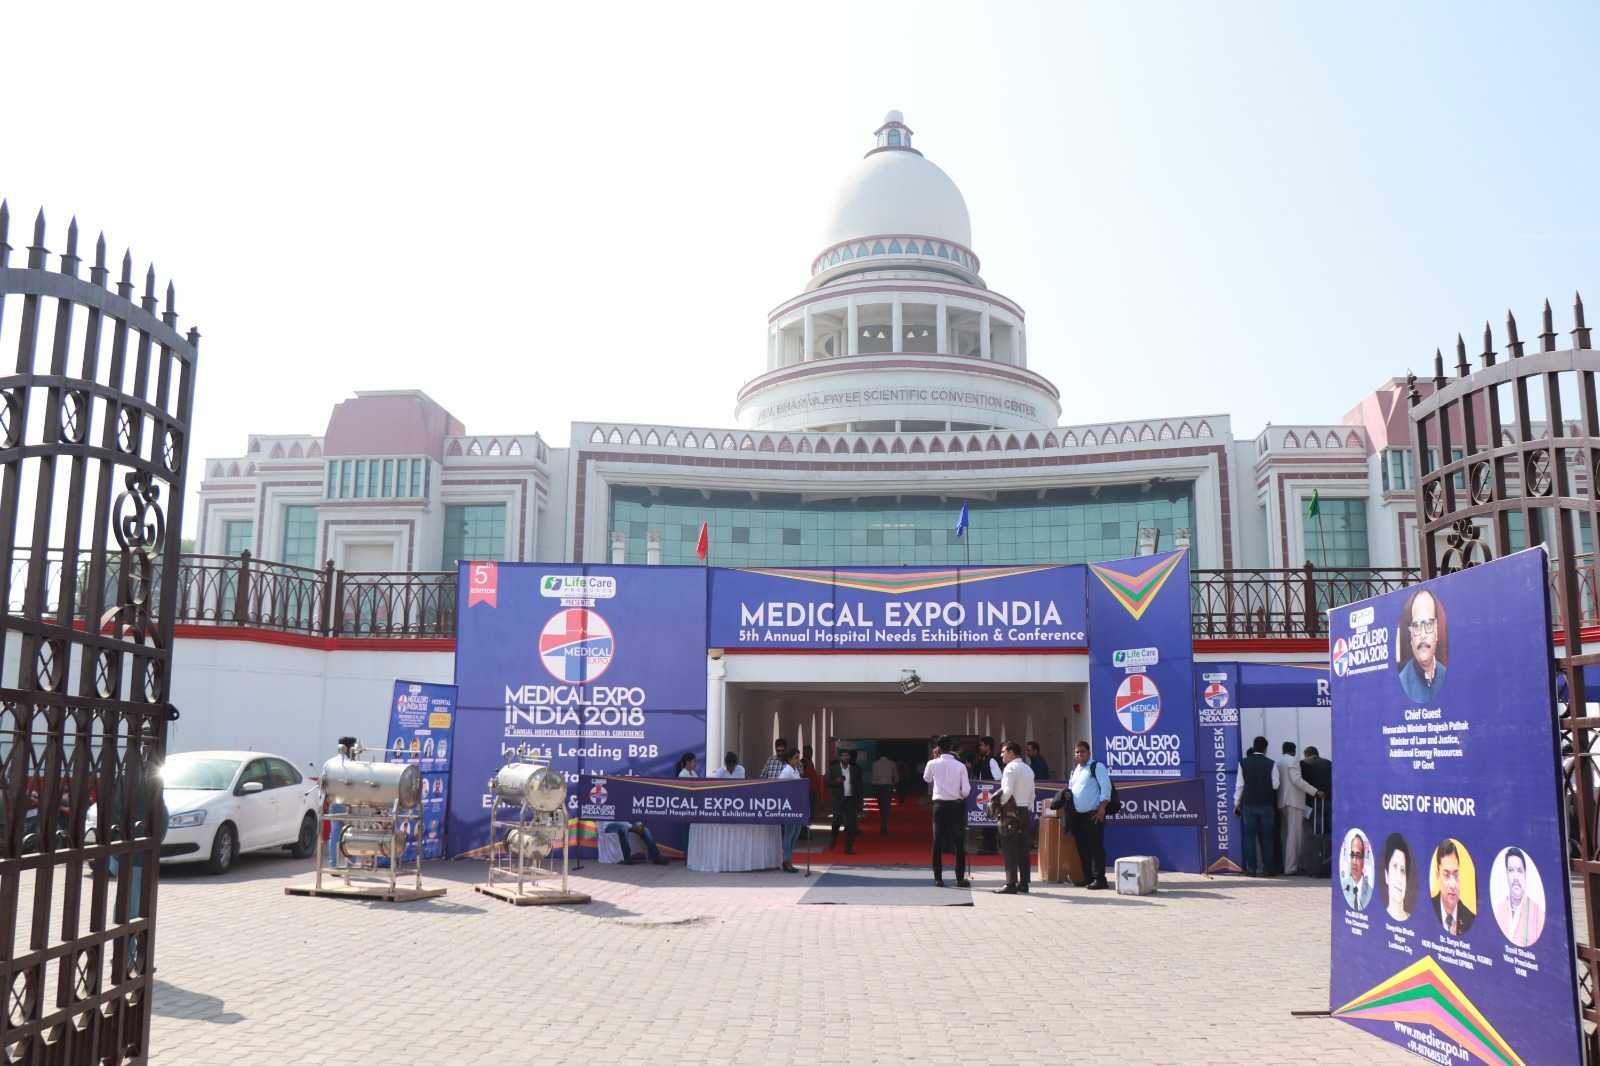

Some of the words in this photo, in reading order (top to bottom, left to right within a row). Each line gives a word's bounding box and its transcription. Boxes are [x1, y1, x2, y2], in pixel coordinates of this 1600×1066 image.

[863, 389, 928, 401] SCIENTIFIC
[930, 391, 1002, 408] CONVENTION
[1003, 399, 1036, 417] CENTER
[564, 576, 587, 587] Life
[589, 577, 612, 588] Care
[741, 601, 874, 627] MEDICAL
[885, 601, 966, 627] EXPO
[977, 600, 1063, 626] INDIA
[739, 629, 760, 642] 5th
[763, 629, 810, 642] Annual
[815, 629, 870, 645] Hospital
[875, 629, 917, 643] Needs
[921, 629, 989, 642] Exhibition
[993, 629, 1003, 642] &
[1008, 627, 1085, 641] Conference
[1348, 631, 1372, 651] MEDICAL
[564, 647, 611, 657] MEDICAL
[1348, 647, 1371, 667] INDIA
[1370, 644, 1389, 663] 2018
[588, 657, 609, 665] EXPO
[505, 685, 592, 706] MEDICAL
[593, 686, 646, 706] EXPO
[505, 705, 581, 725] INDIA
[584, 706, 646, 726] 2018
[1130, 703, 1159, 713] MEDICAL
[1404, 709, 1421, 721] Chief
[1421, 708, 1442, 720] Guest
[1105, 735, 1151, 751] MEDICAL
[1151, 734, 1180, 751] EXPO
[1214, 727, 1225, 758] DESK
[1410, 735, 1416, 745] of
[1416, 736, 1427, 745] Law
[1427, 735, 1437, 745] and
[558, 743, 623, 761] Leading
[628, 744, 659, 758] B2B
[1106, 751, 1146, 766] INDIA
[1146, 750, 1180, 766] 2018
[1414, 747, 1433, 760] Energy
[1433, 747, 1463, 757] Resources
[1413, 760, 1421, 770] UP
[568, 795, 578, 809] &
[632, 796, 698, 809] MEDICAL
[704, 797, 745, 810] EXPO
[749, 797, 792, 811] INDIA
[1119, 800, 1138, 813] PO
[1143, 799, 1187, 812] INDIA
[1216, 762, 1229, 850] REGISTRATION
[1382, 793, 1414, 812] GUEST
[1416, 795, 1430, 813] OF
[1433, 797, 1476, 816] HONOR
[644, 808, 668, 816] Annual
[669, 808, 698, 817] Hospital
[722, 810, 756, 818] Exhibition
[1159, 811, 1198, 820] Conference
[1393, 1021, 1470, 1062] www.mediexpo.in
